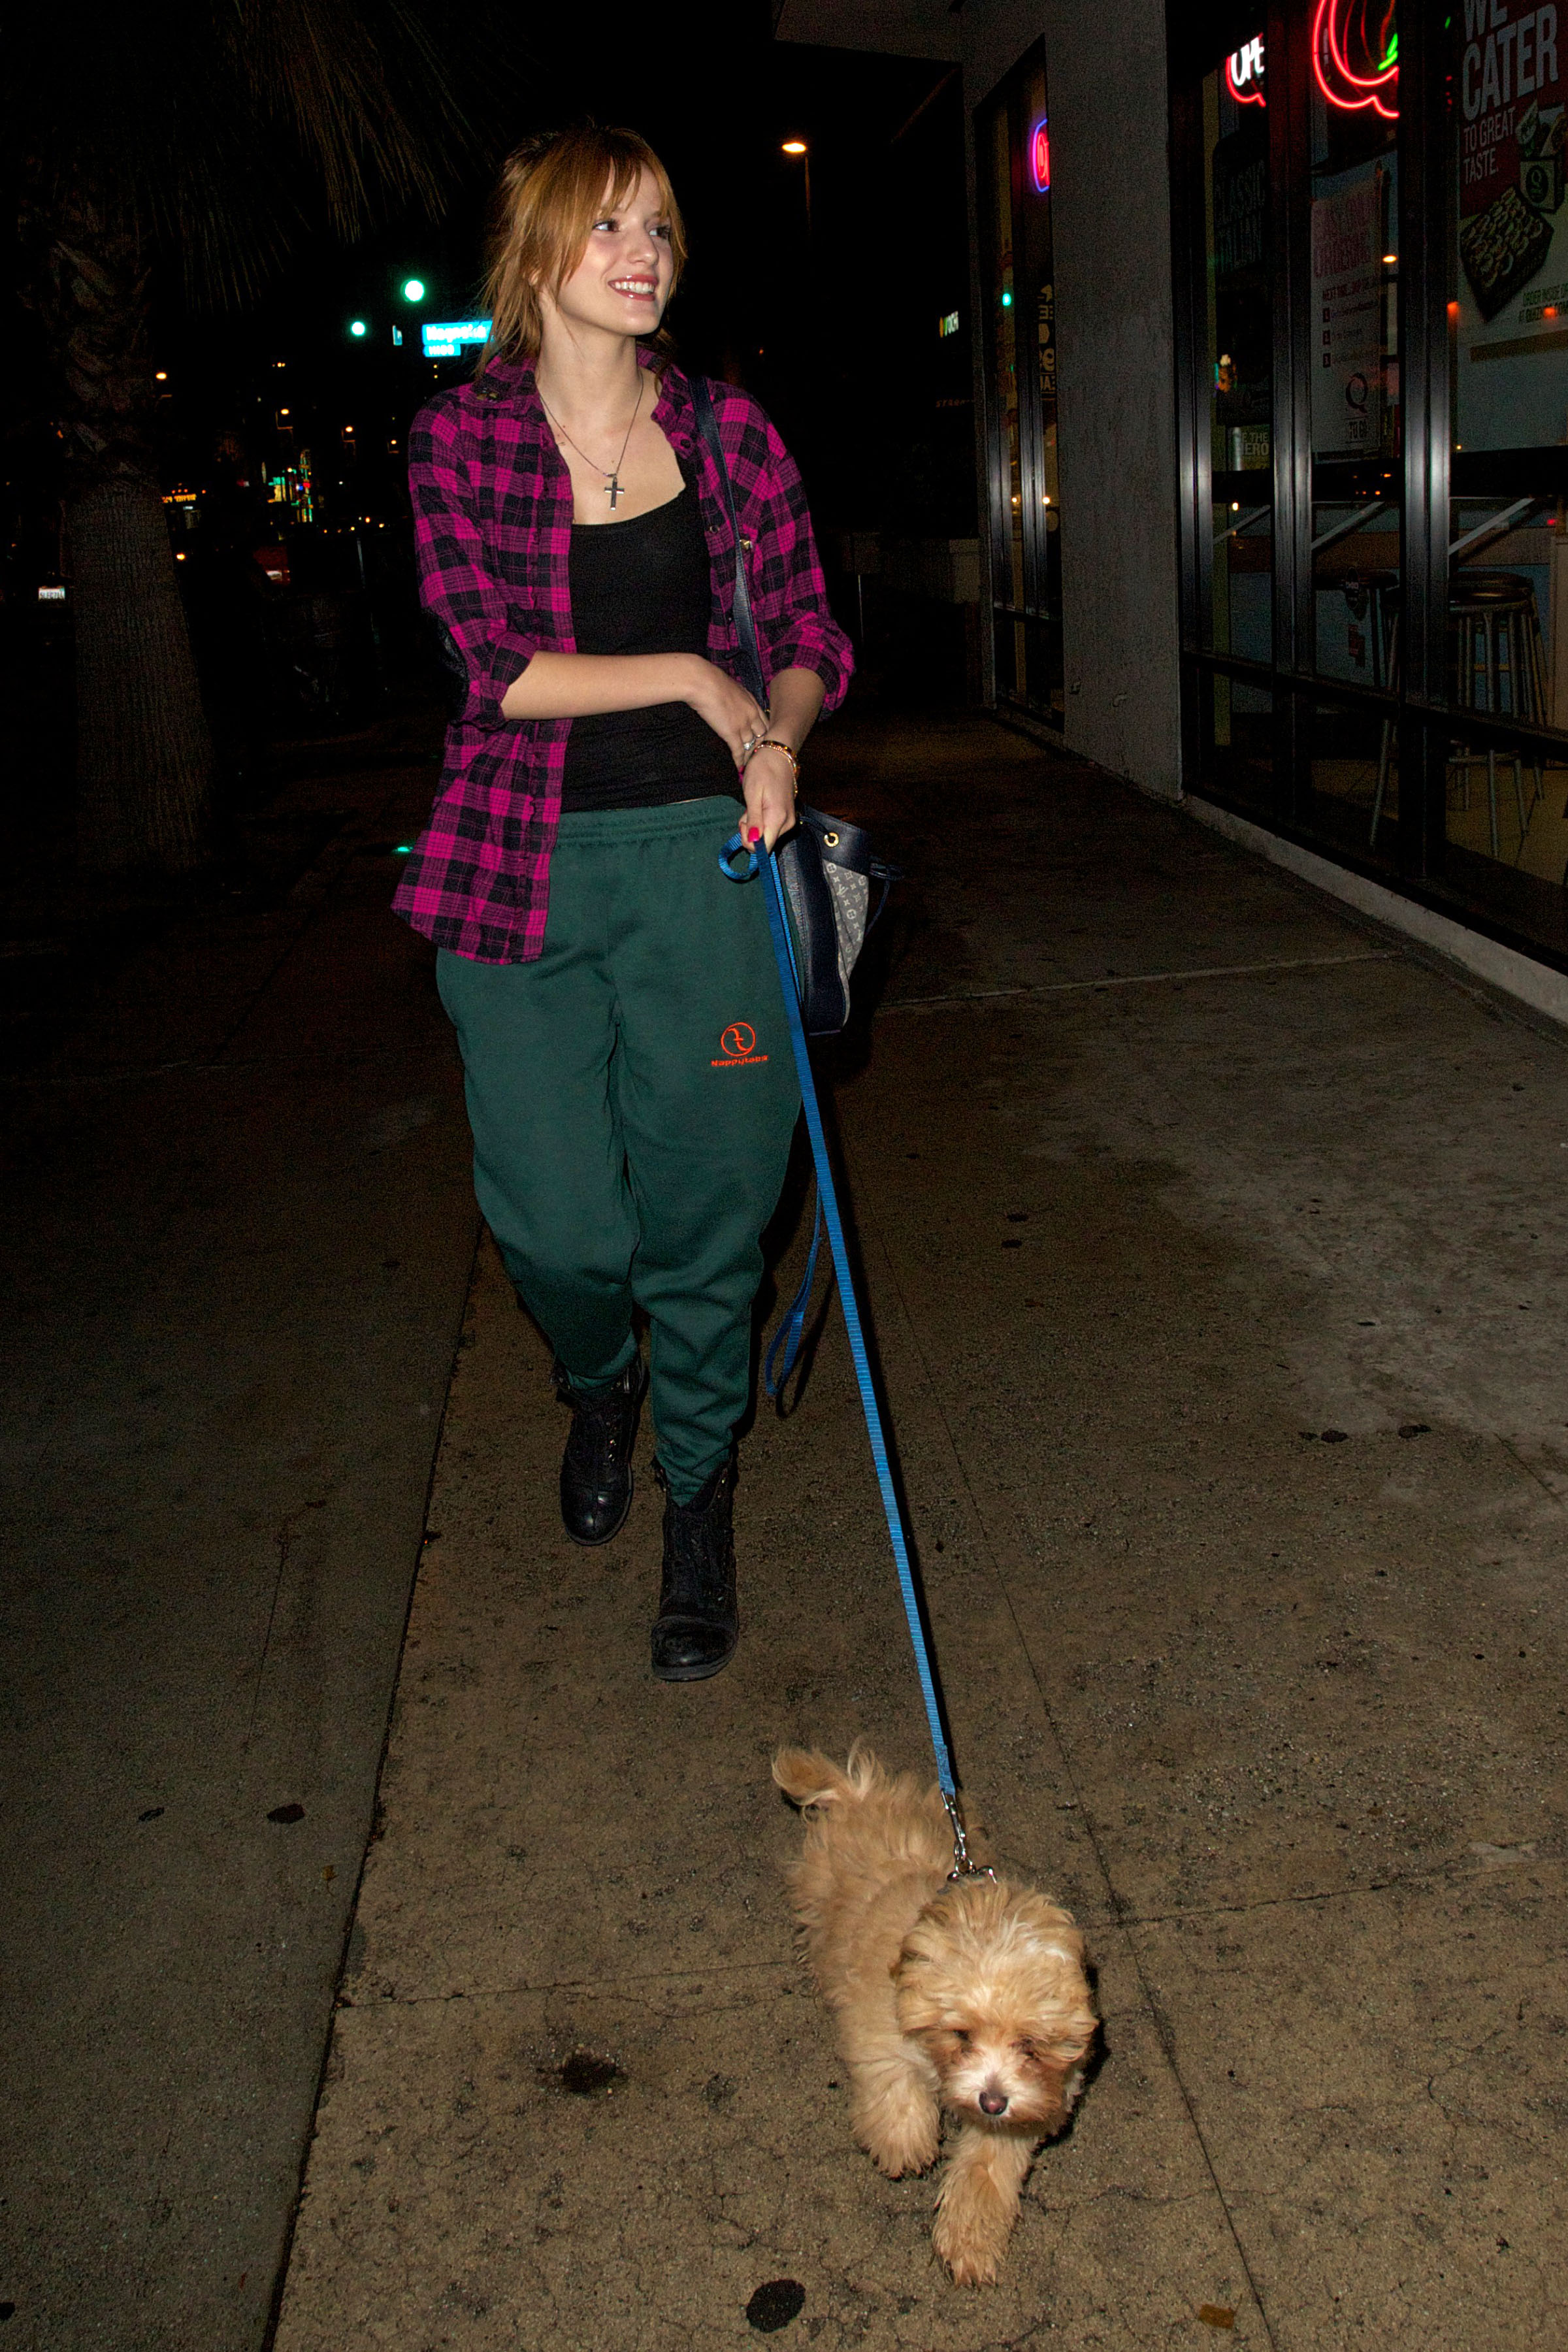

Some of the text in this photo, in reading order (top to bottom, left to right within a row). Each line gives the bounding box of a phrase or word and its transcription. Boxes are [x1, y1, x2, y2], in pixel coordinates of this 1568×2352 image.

[1463, 3, 1558, 120] CATER
[1463, 106, 1516, 154] TO GREAT
[1463, 148, 1499, 184] TASTE.
